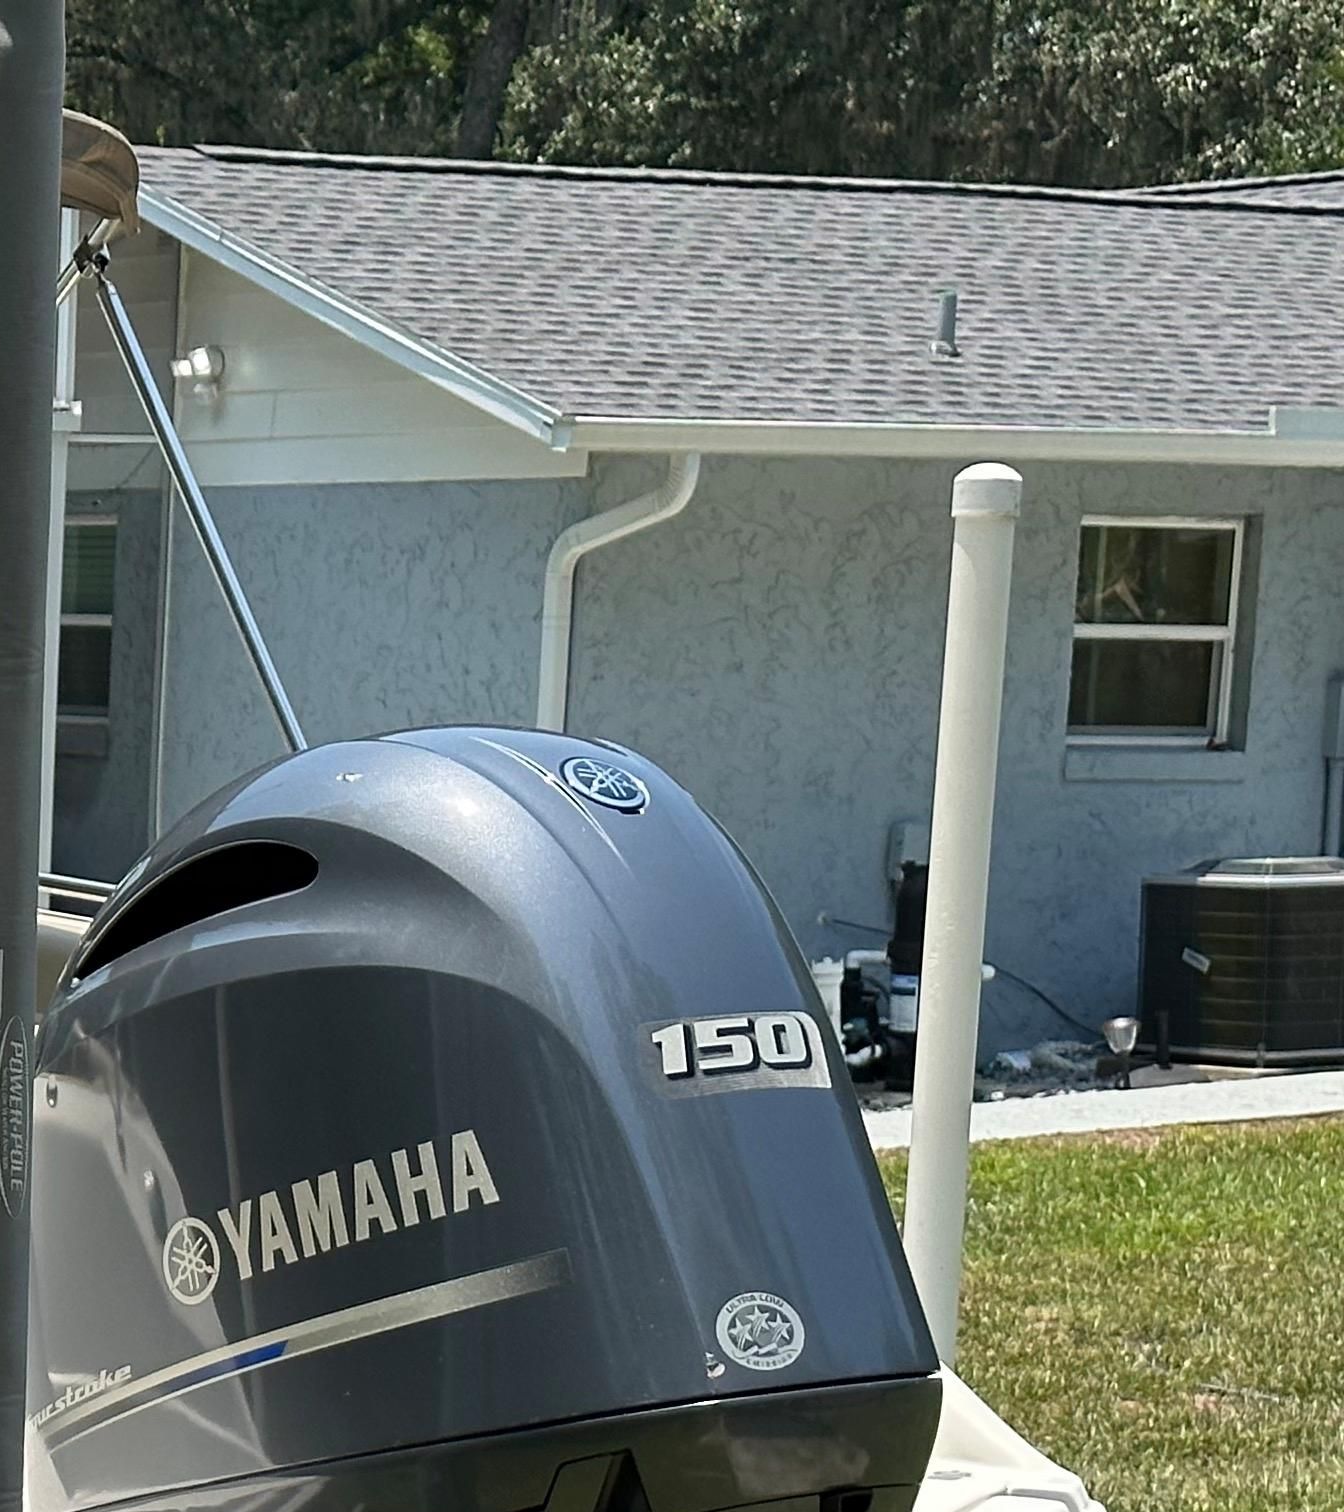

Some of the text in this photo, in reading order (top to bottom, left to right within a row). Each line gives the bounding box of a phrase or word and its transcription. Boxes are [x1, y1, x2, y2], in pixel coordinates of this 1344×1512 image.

[651, 1016, 812, 1080] 150
[9, 1039, 24, 1192] POWER-POLE
[217, 1129, 500, 1280] YAMAHA
[725, 1294, 784, 1314] ULTRA LOW
